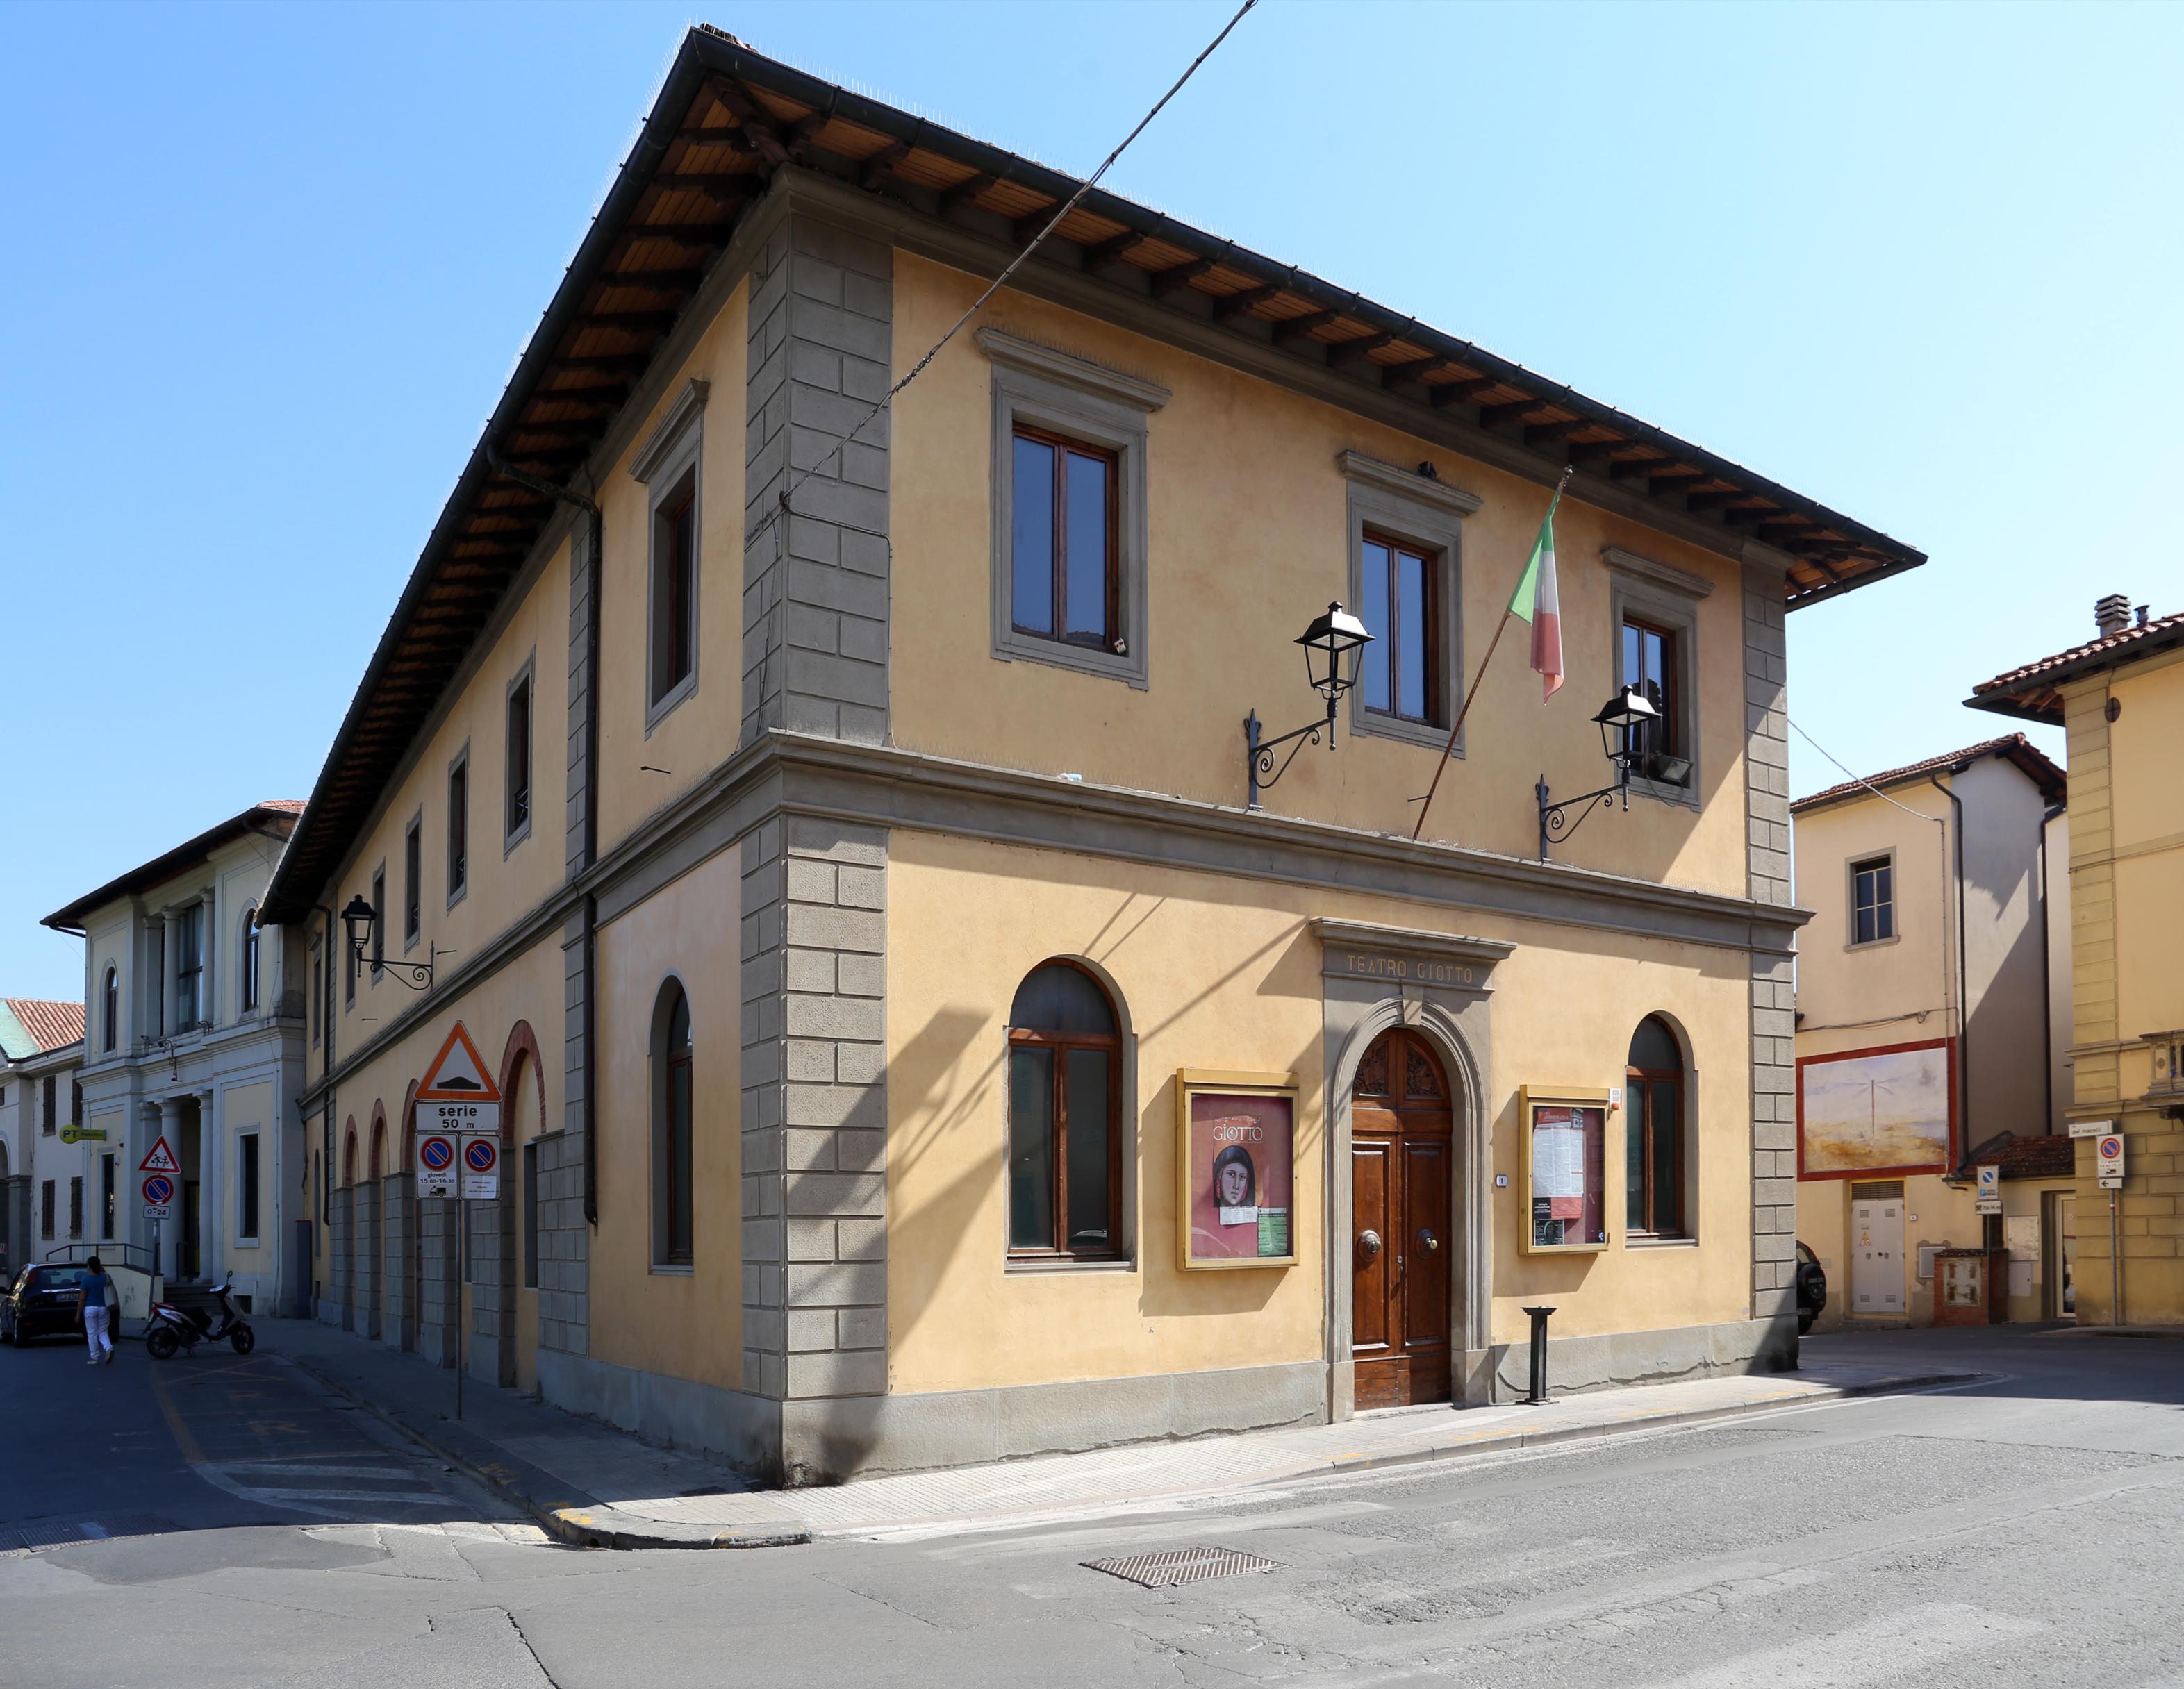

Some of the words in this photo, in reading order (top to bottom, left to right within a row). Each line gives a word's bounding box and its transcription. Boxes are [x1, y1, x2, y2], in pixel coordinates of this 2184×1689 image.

[1347, 955, 1407, 977] TEATRO
[1417, 963, 1473, 983] GIOTTO
[438, 1105, 477, 1116] serie
[442, 1119, 458, 1129] 50
[63, 1129, 78, 1138] PT
